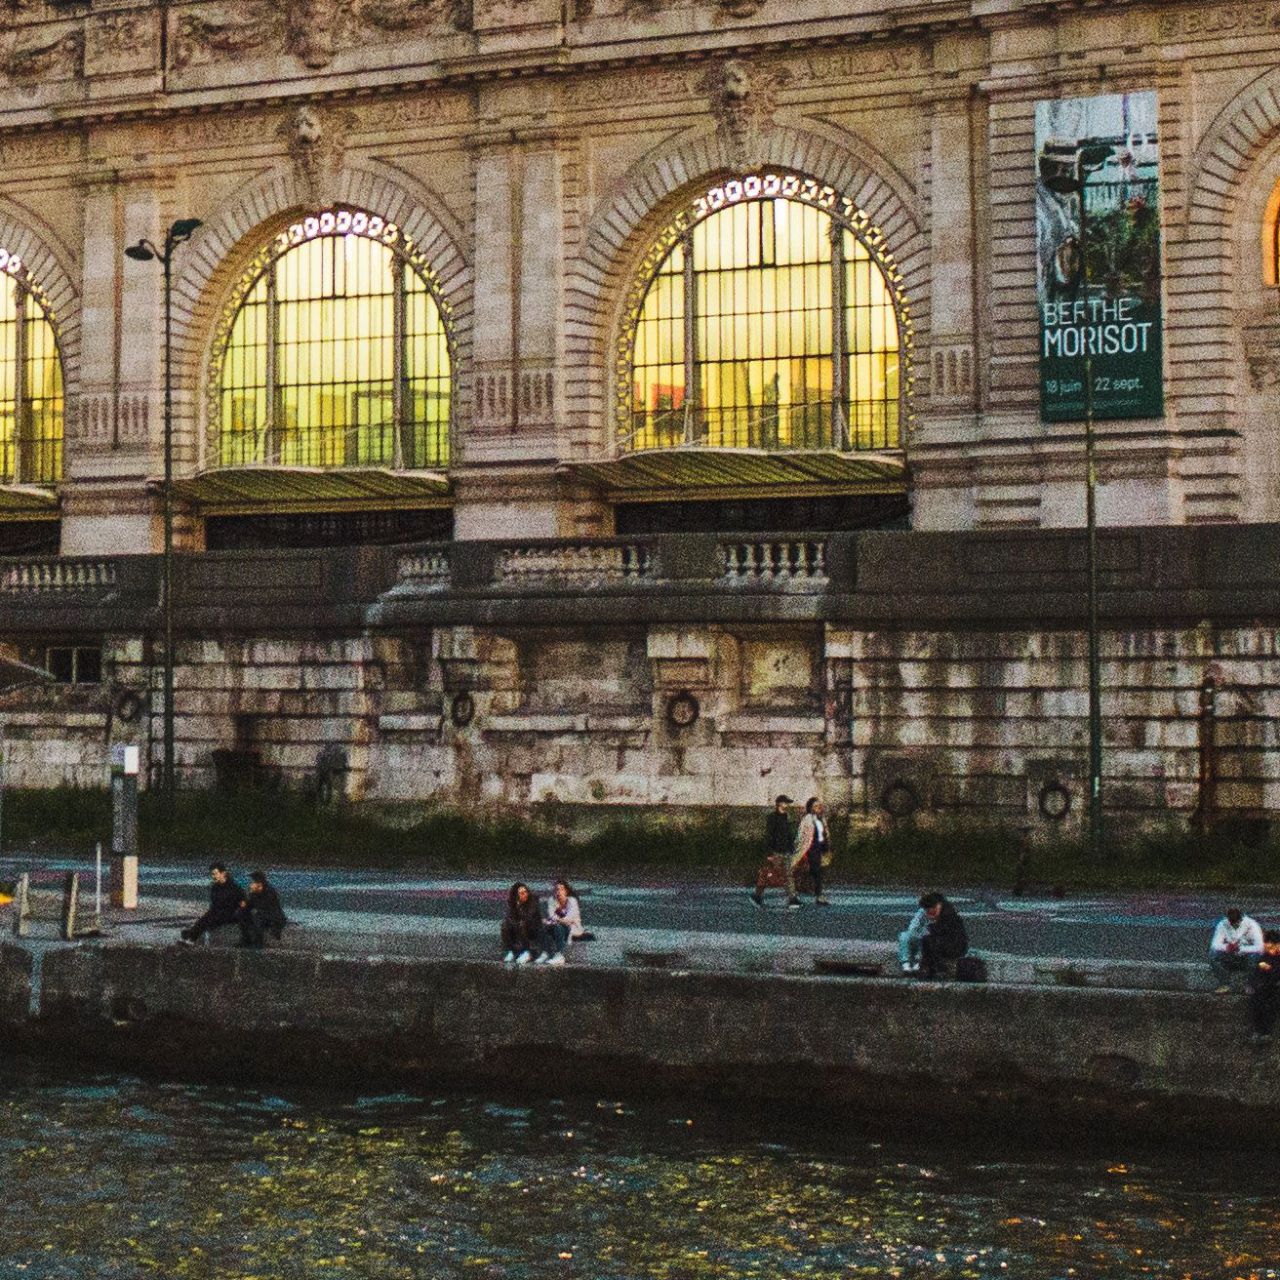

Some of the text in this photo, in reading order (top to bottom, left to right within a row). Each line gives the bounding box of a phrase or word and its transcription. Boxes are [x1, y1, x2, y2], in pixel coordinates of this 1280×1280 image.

[1043, 298, 1133, 326] BERTHE
[1043, 322, 1152, 357] MORISOT
[1095, 377, 1111, 391] 22
